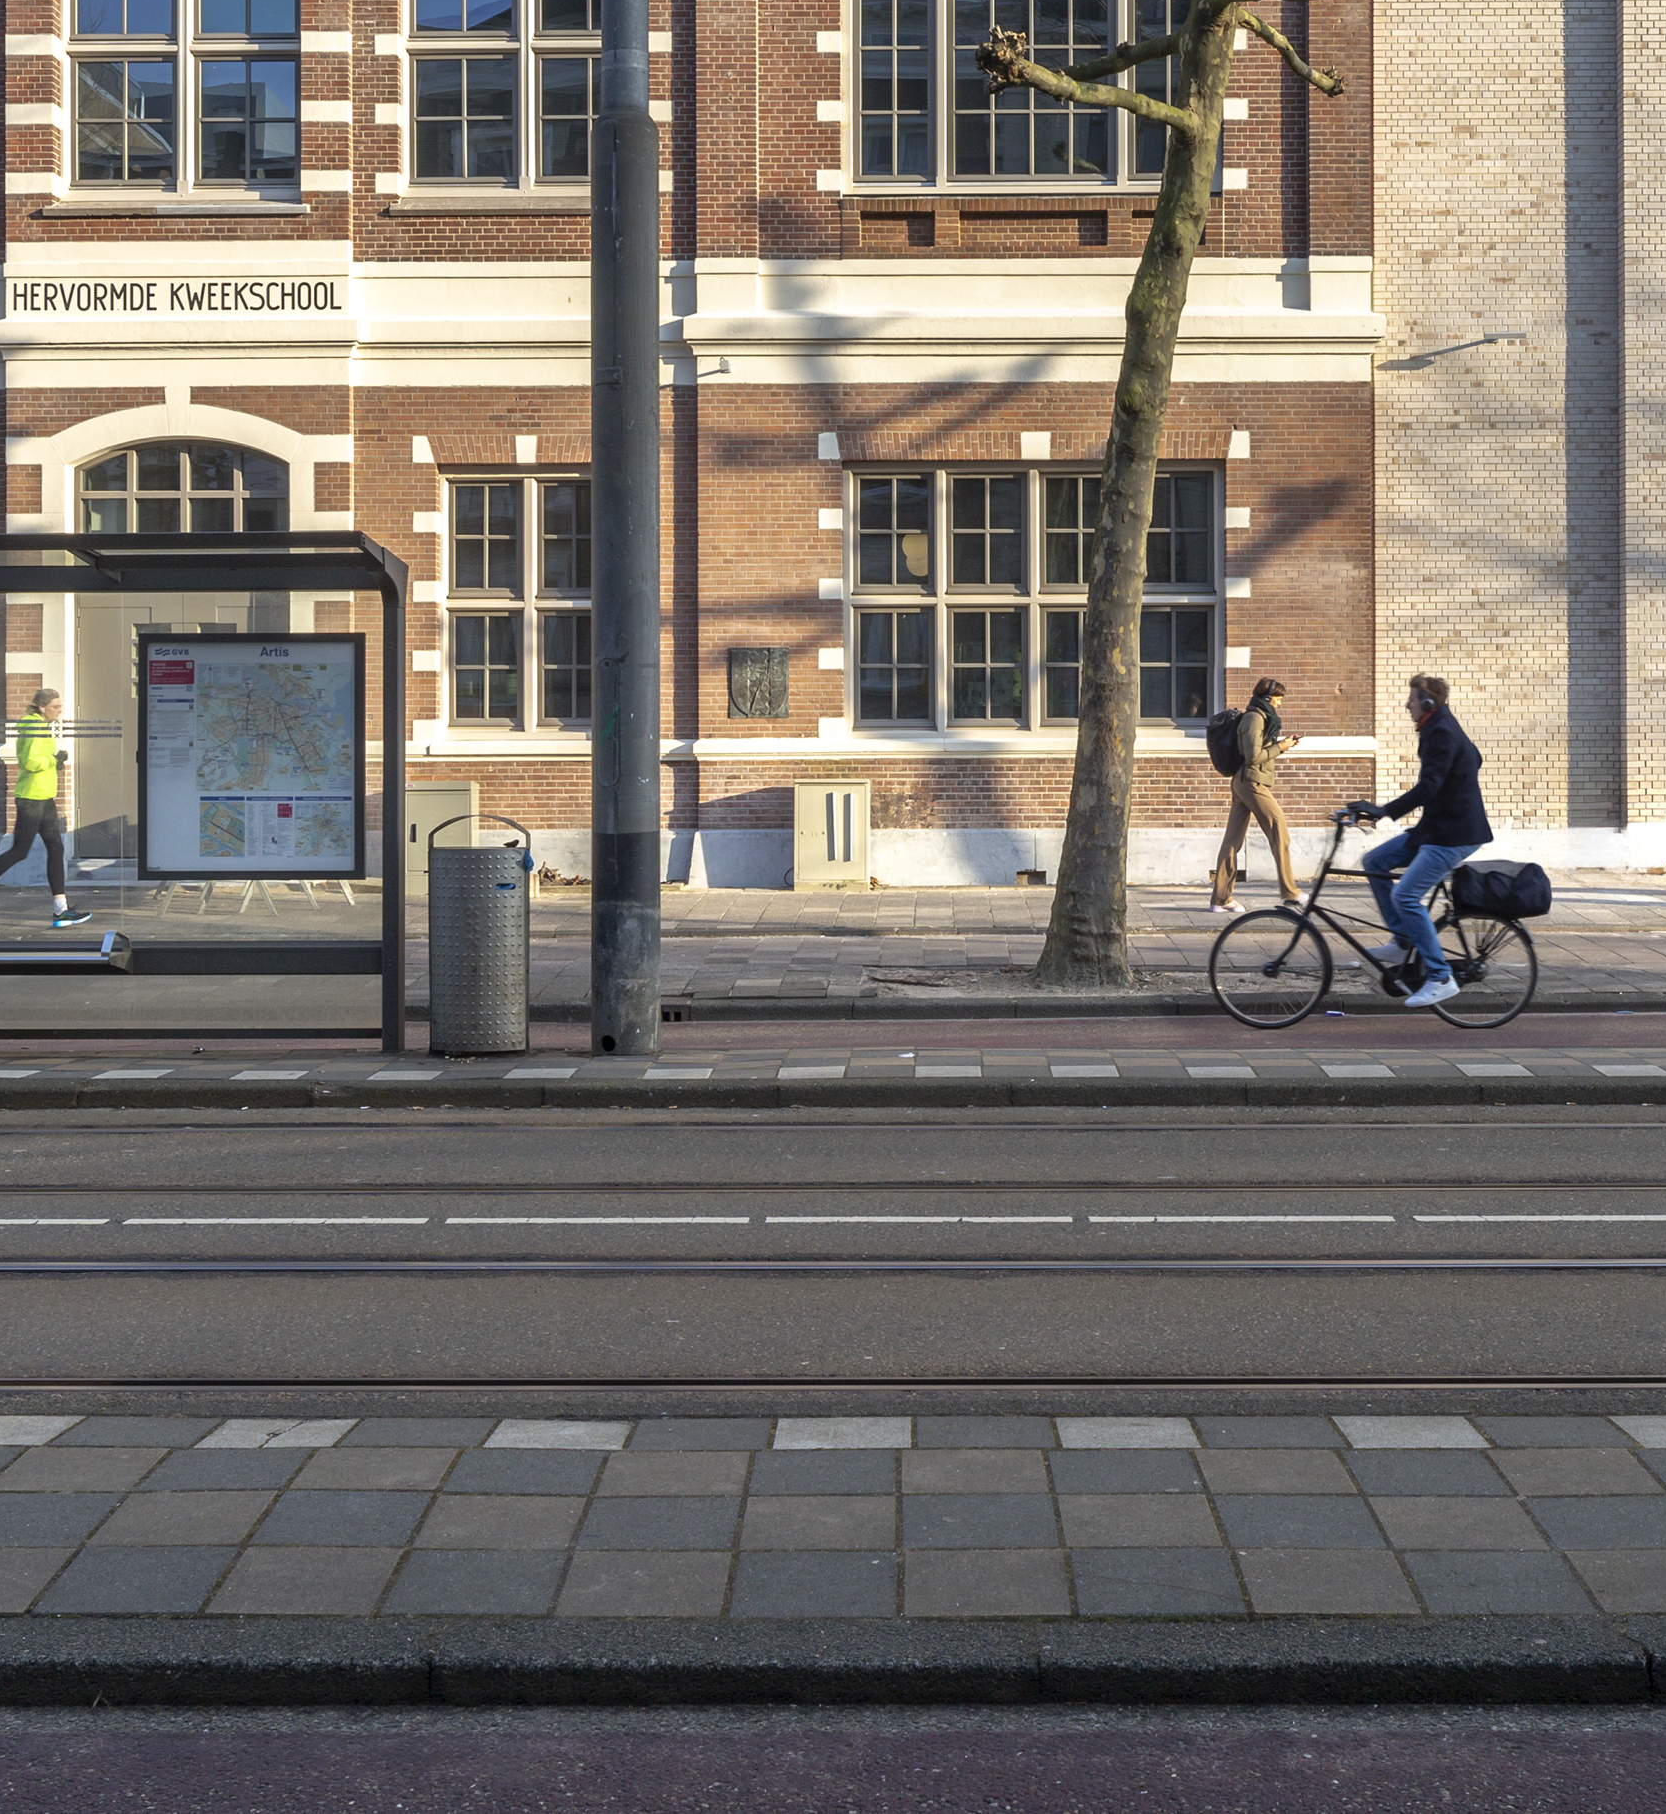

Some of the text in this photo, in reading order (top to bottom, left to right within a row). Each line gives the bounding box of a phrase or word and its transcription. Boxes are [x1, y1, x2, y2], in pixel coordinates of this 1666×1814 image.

[13, 281, 343, 312] HERVORMDE KWEEKSCHOOL
[171, 648, 190, 656] GVB
[259, 645, 289, 658] Artis
